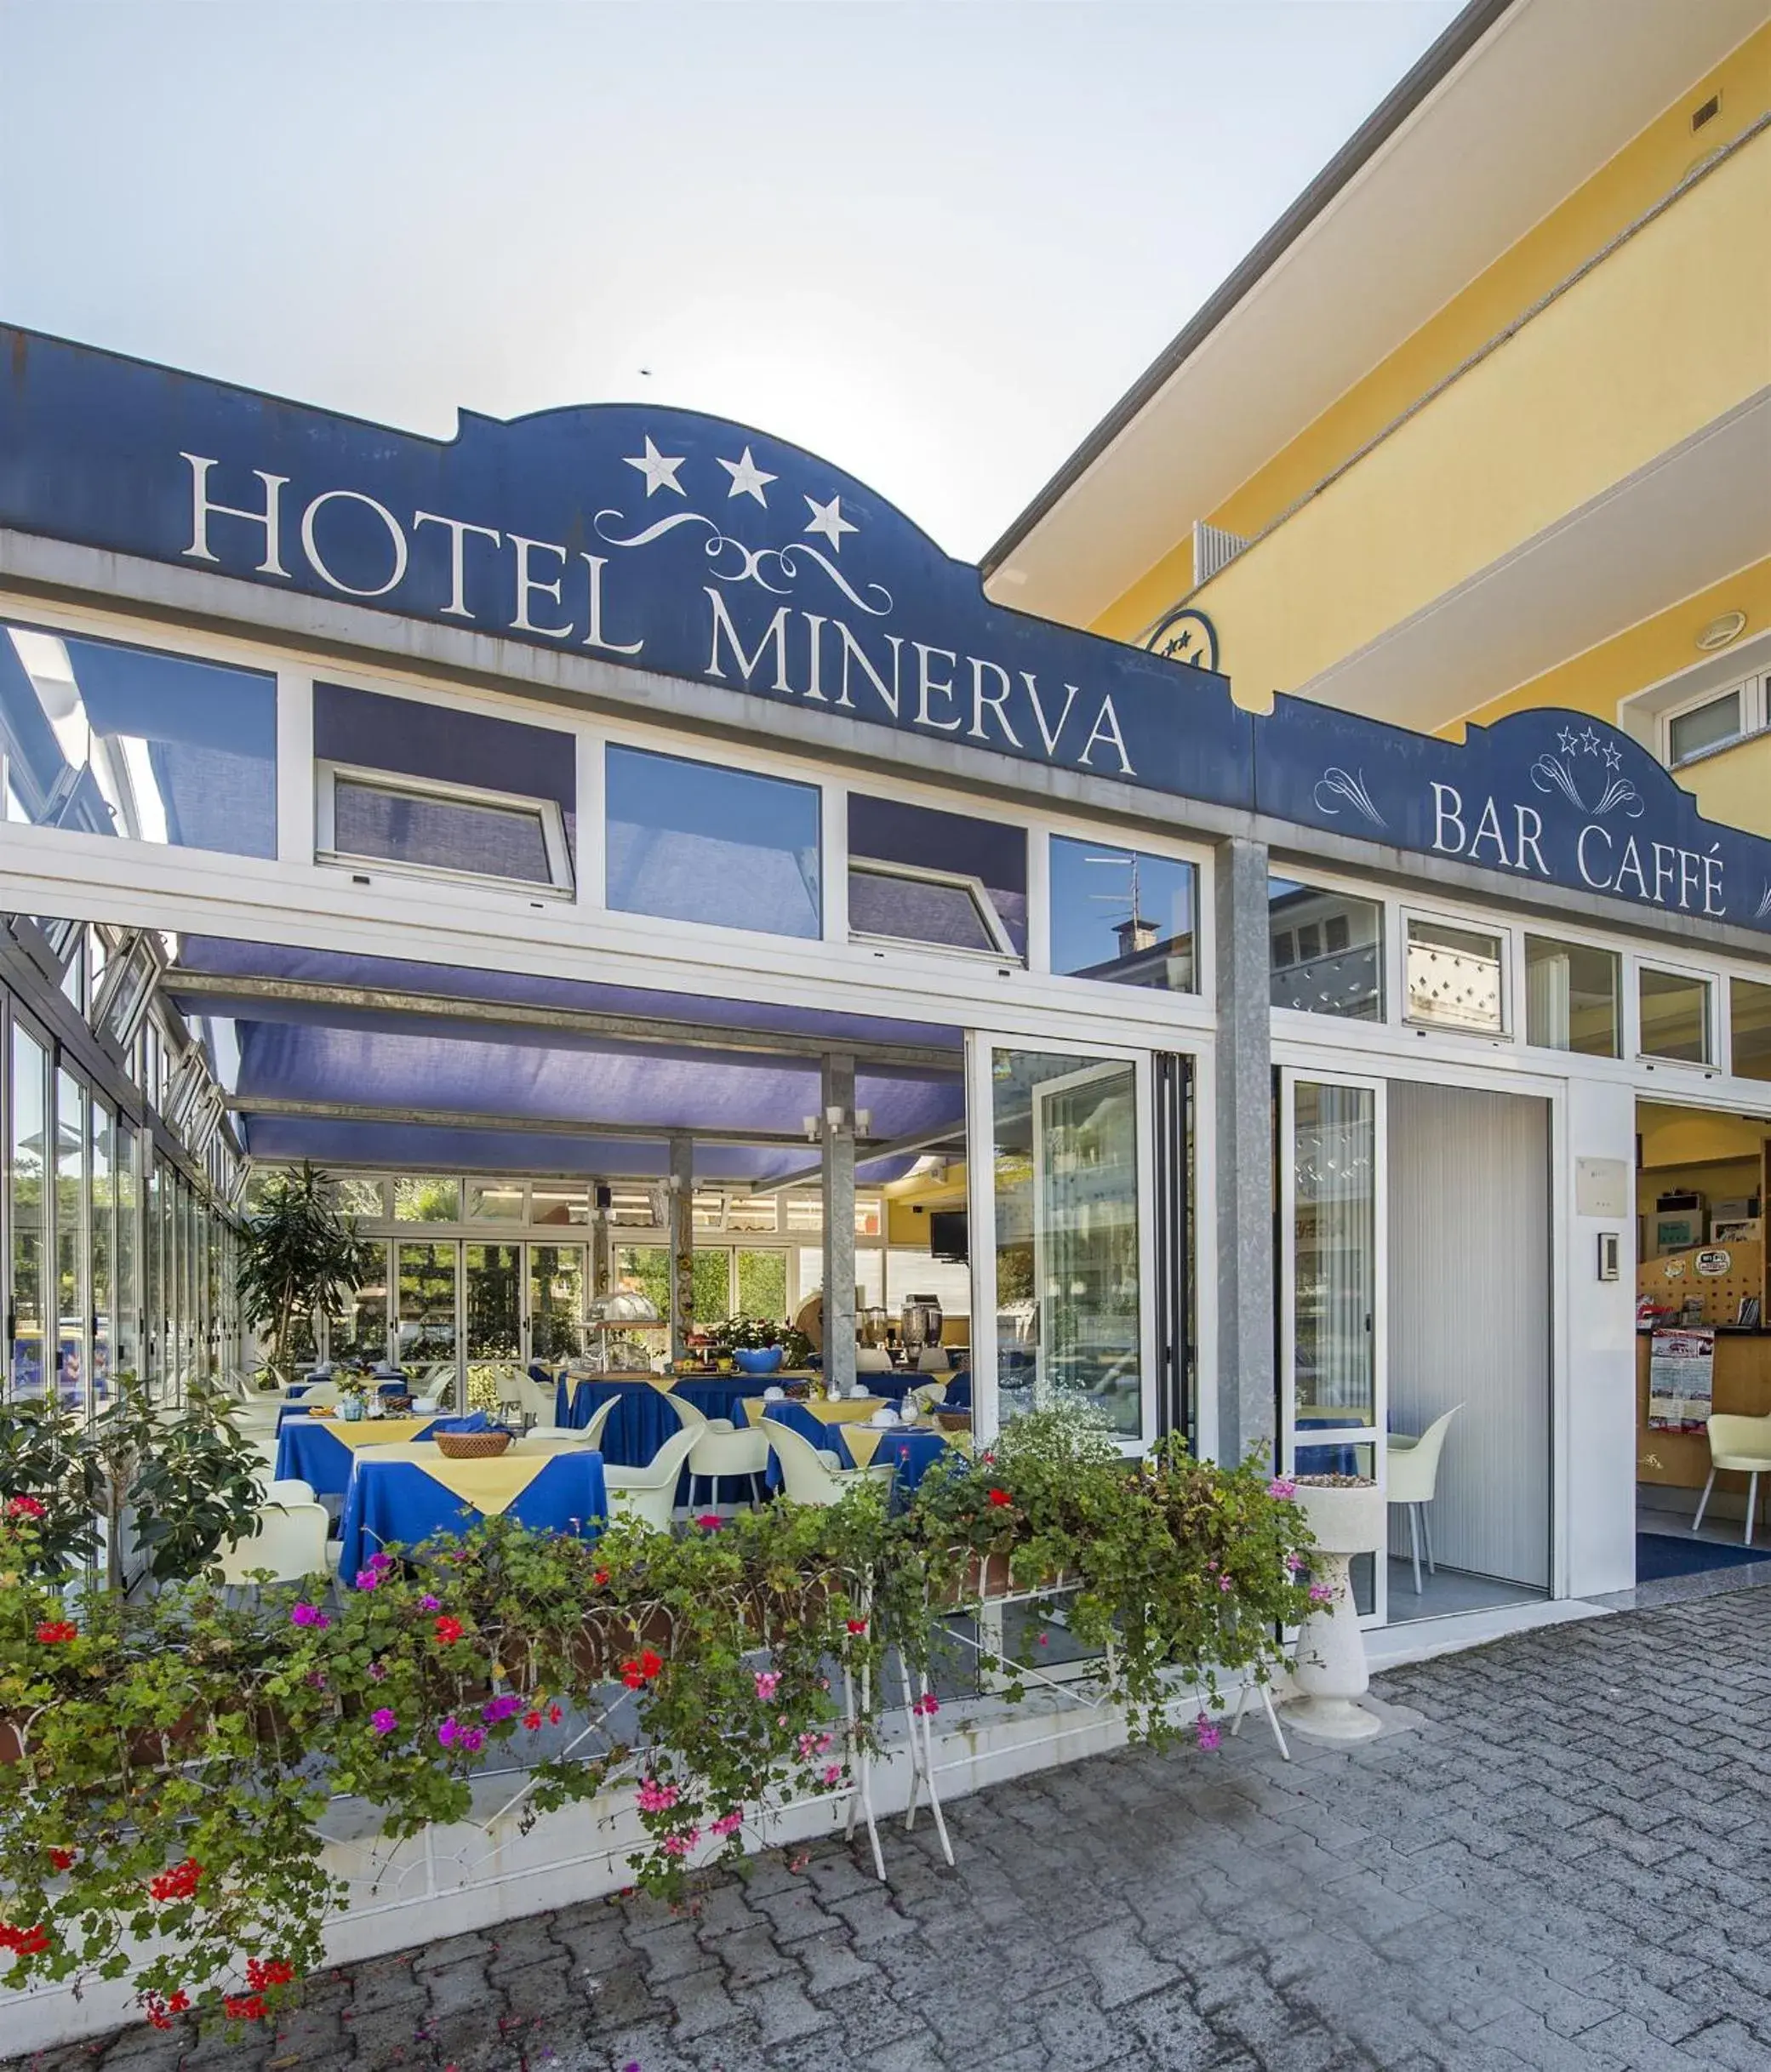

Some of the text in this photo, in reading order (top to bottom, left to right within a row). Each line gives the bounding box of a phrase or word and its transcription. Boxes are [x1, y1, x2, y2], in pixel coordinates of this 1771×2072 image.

[179, 452, 1138, 776] HOTEL MINERVA
[1430, 781, 1727, 916] BAR CAFFÉ
